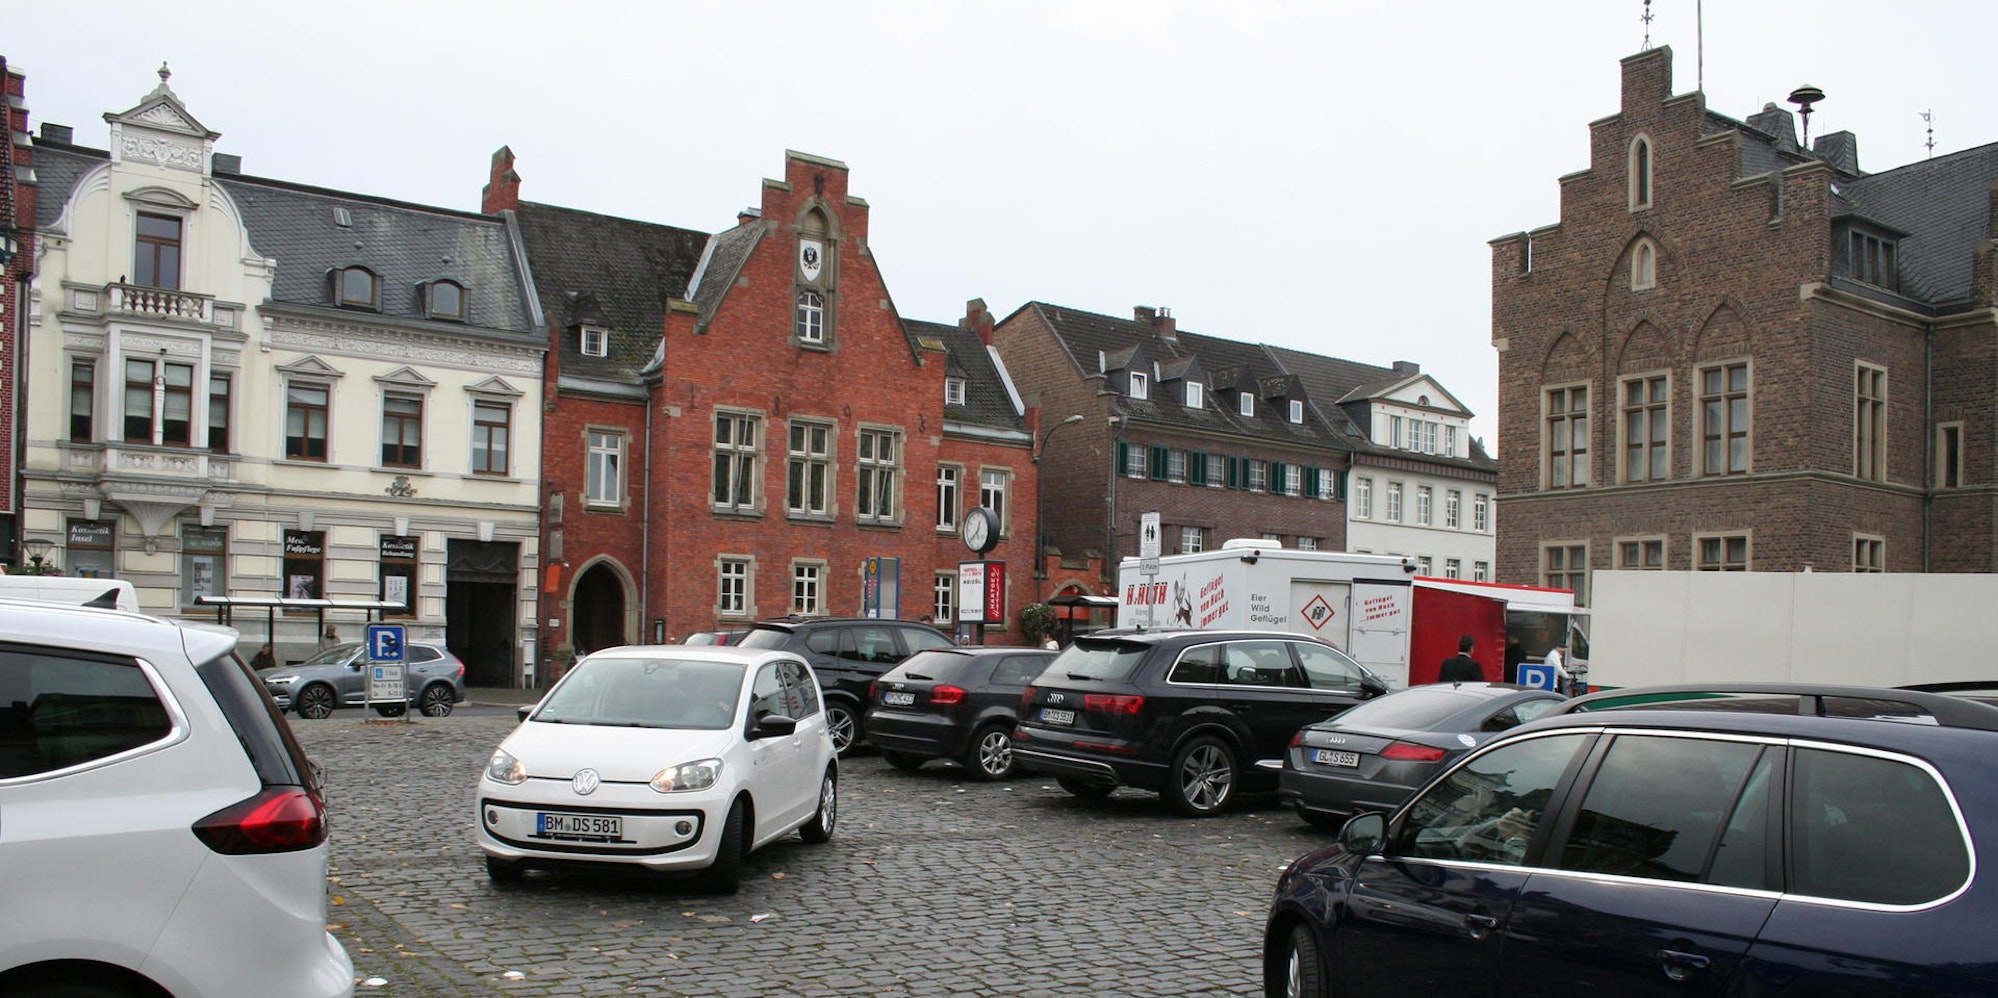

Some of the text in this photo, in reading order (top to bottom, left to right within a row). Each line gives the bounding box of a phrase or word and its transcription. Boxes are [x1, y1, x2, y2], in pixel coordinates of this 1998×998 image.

[71, 534, 93, 543] Insel
[1251, 604, 1269, 612] Wild
[1251, 614, 1287, 624] Geflügel
[377, 631, 397, 657] P
[1320, 751, 1355, 764] GL S 655
[546, 816, 619, 834] BM DS 581
